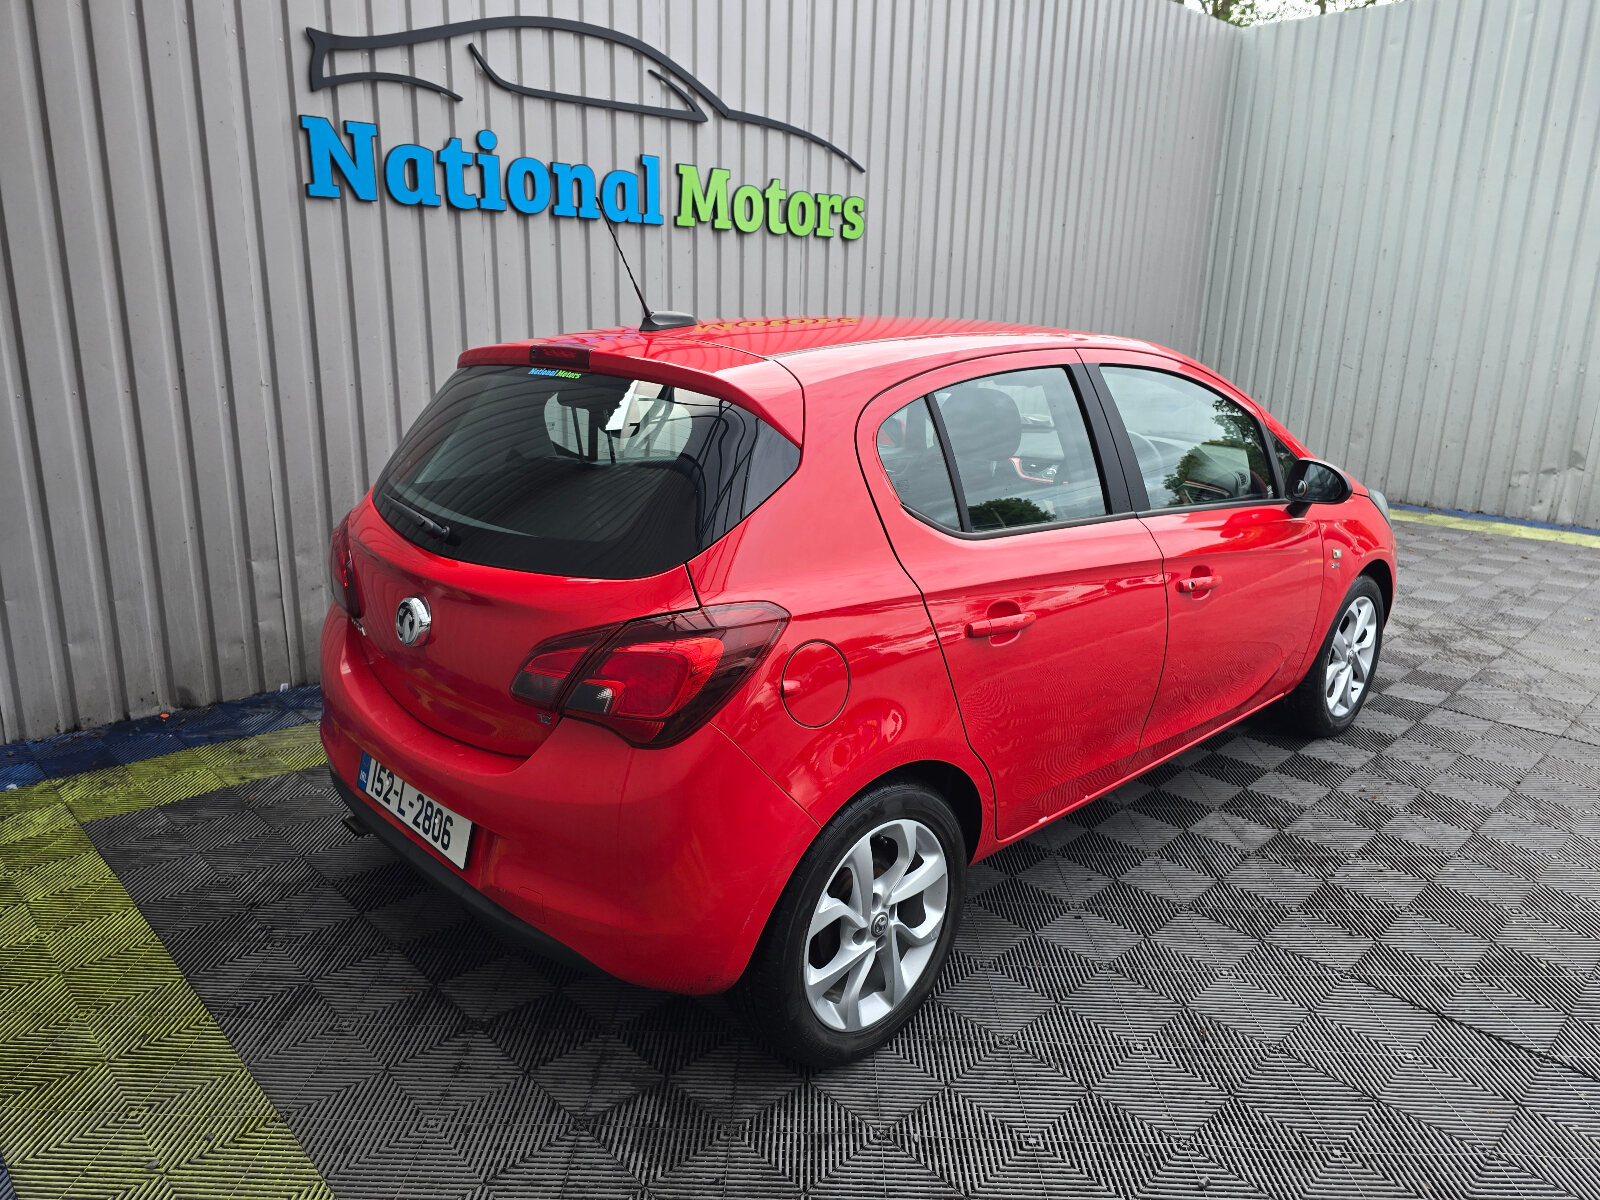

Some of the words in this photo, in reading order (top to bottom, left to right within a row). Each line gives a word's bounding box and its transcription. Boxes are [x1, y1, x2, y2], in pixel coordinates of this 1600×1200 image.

[300, 115, 664, 225] National
[676, 163, 866, 240] Motors
[528, 367, 559, 377] National
[555, 369, 582, 379] Motors
[370, 761, 454, 851] 152-L-2806
